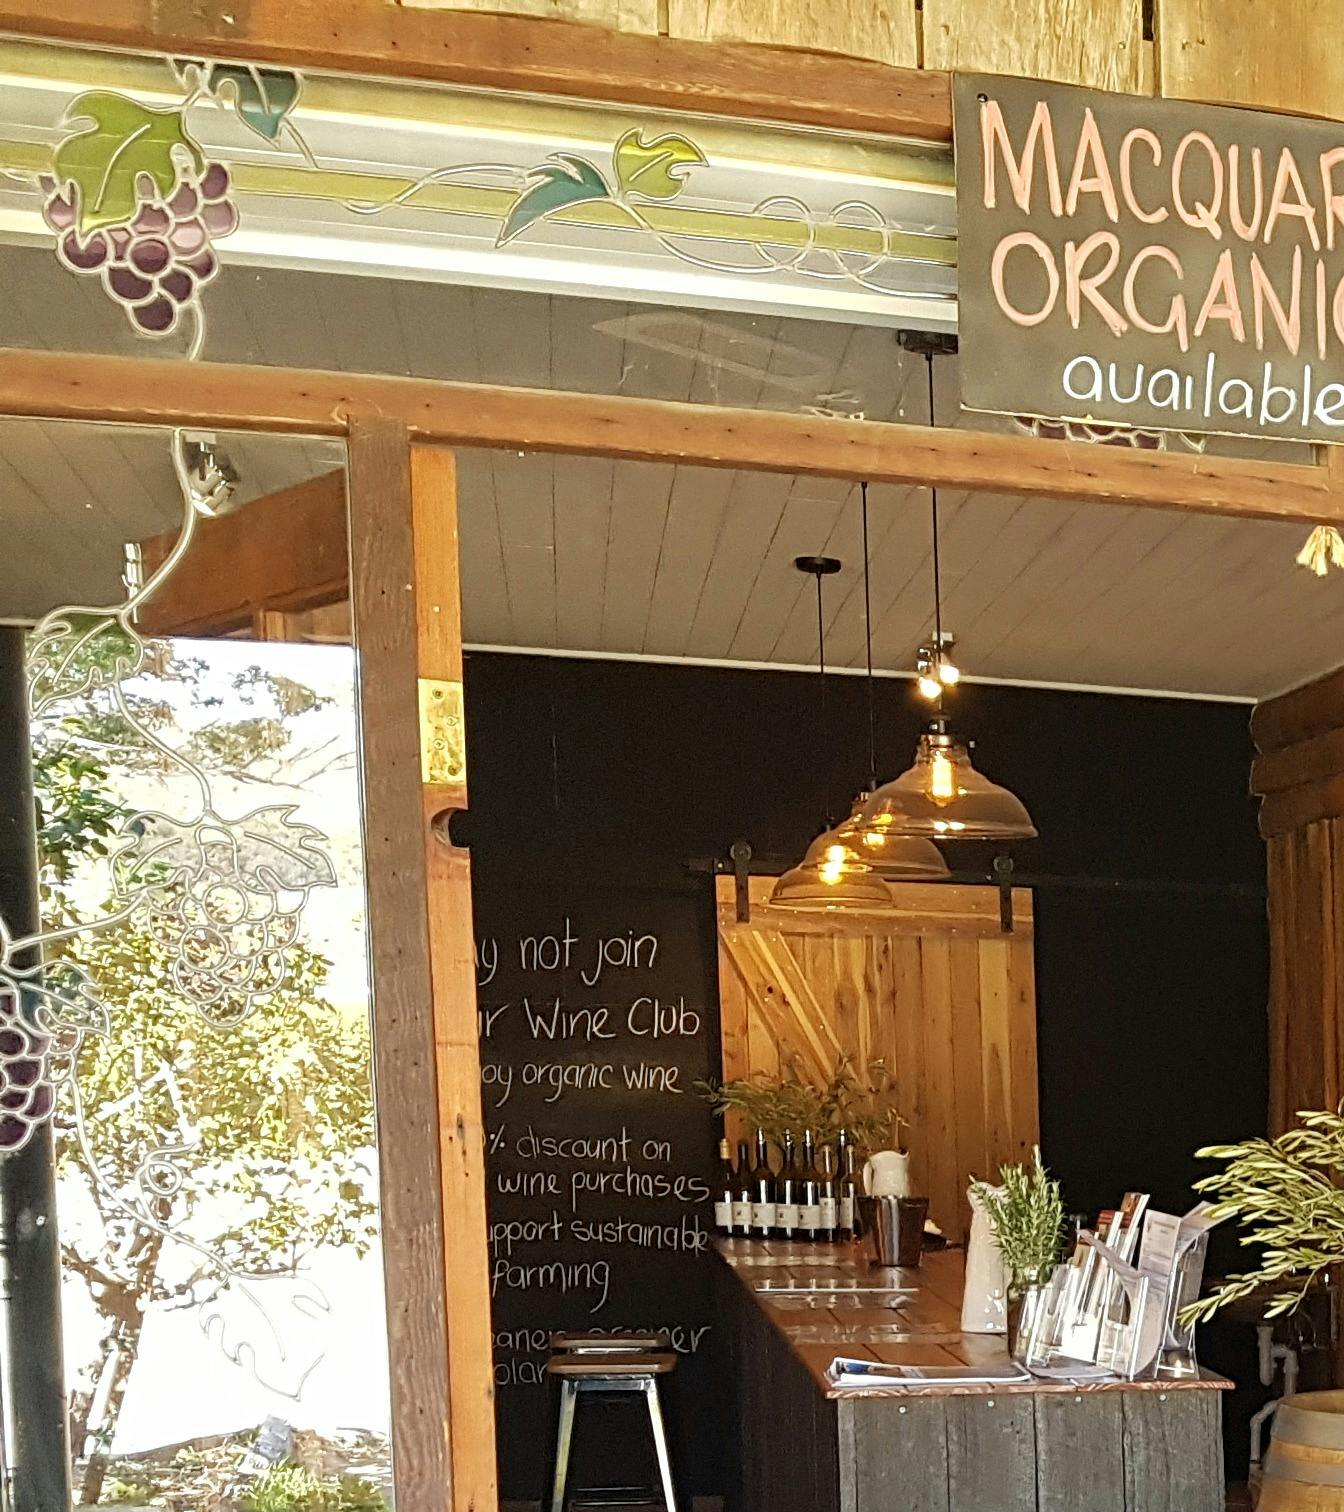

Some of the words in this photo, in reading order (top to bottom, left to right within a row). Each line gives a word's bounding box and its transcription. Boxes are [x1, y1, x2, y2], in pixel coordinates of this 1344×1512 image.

[519, 917, 579, 970] not
[580, 930, 658, 986] join
[523, 997, 617, 1041] Wine
[627, 996, 700, 1039] Club
[522, 1063, 613, 1102] organic
[622, 1062, 684, 1093] wine
[516, 1125, 632, 1162] discount
[642, 1138, 672, 1162] on
[497, 1171, 563, 1196] wine
[571, 1165, 710, 1213] purchases
[491, 1260, 610, 1314] farming
